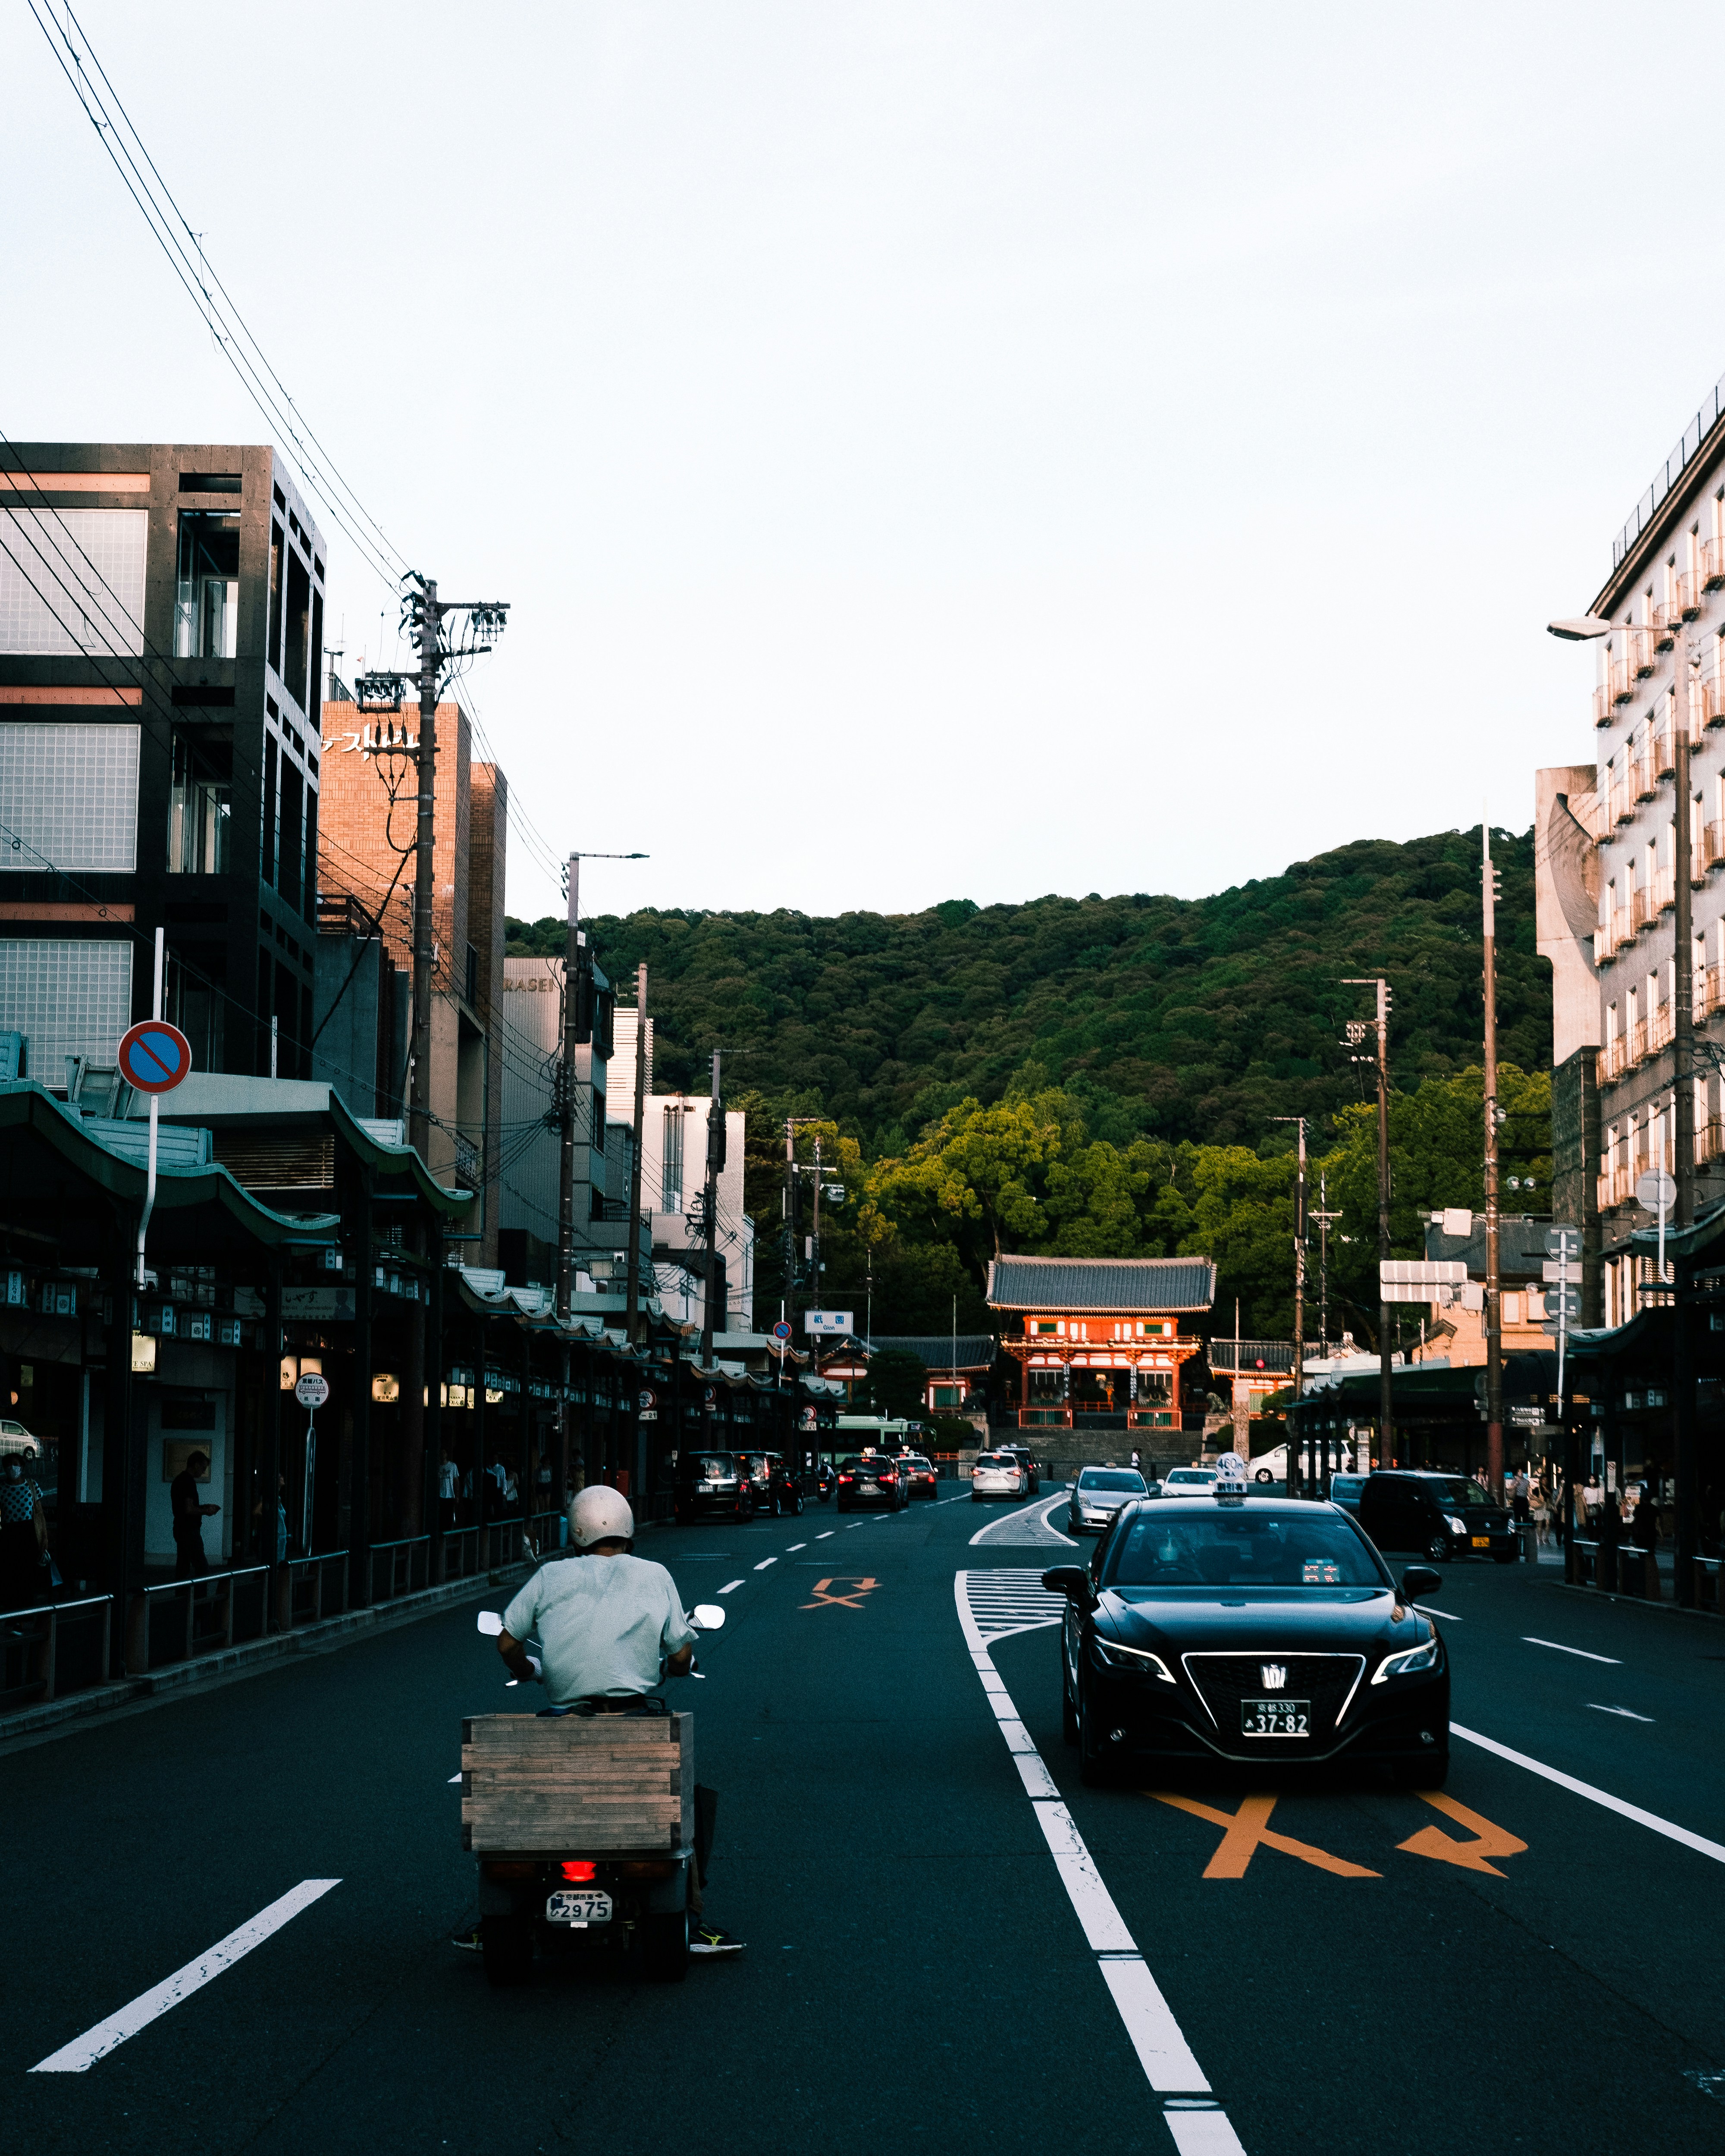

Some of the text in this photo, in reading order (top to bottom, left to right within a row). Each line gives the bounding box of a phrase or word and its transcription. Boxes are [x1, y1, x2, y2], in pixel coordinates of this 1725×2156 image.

[503, 978, 553, 992] RASEI
[1256, 1714, 1307, 1733] 37-82
[561, 1901, 608, 1918] 2975
